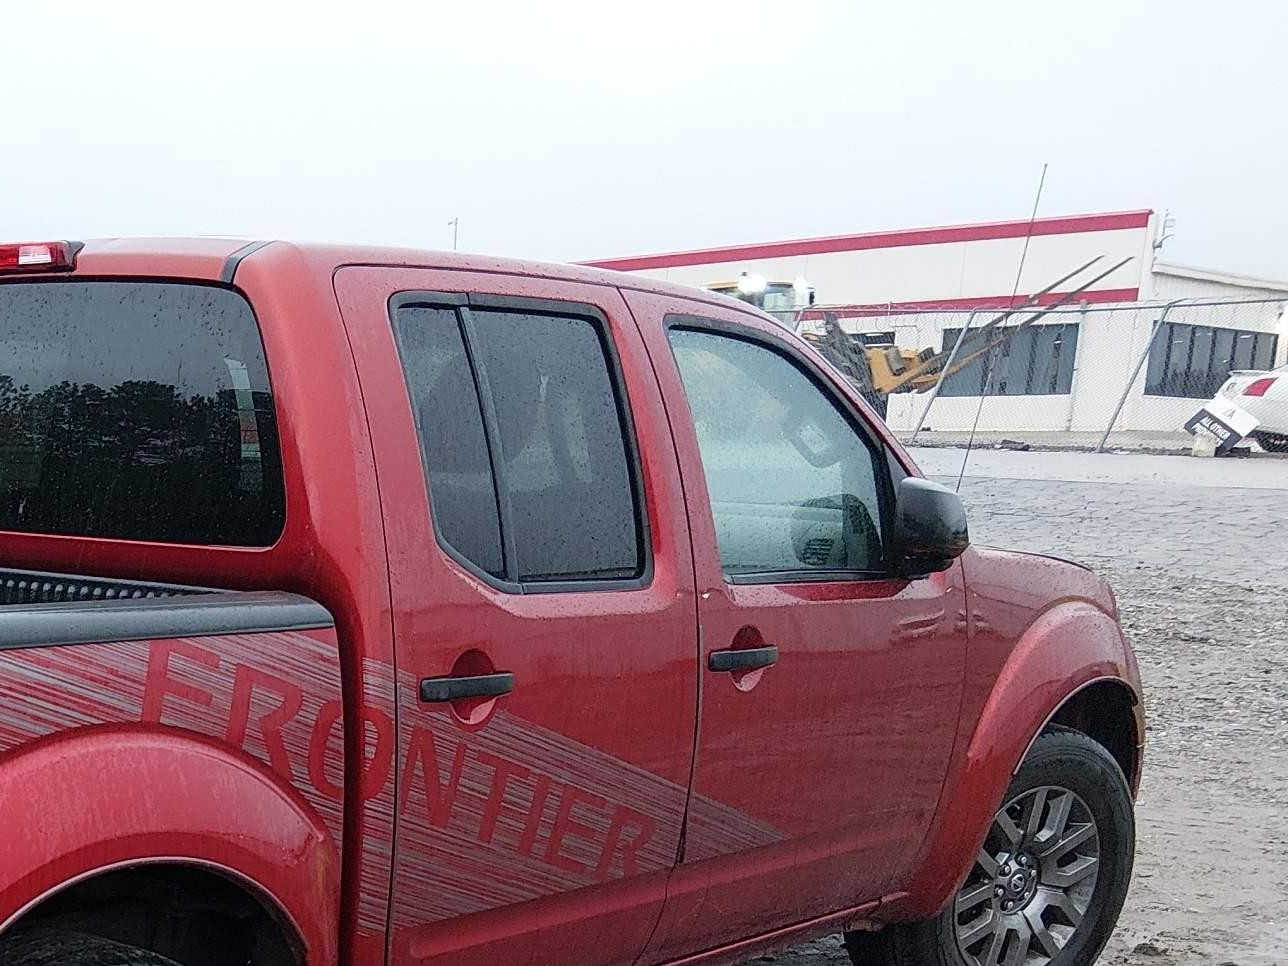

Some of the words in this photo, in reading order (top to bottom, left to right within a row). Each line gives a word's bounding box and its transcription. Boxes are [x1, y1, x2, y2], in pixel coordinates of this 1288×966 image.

[1199, 416, 1214, 430] ALL
[1210, 423, 1232, 440] OTHER
[141, 639, 656, 880] FRONTIER
